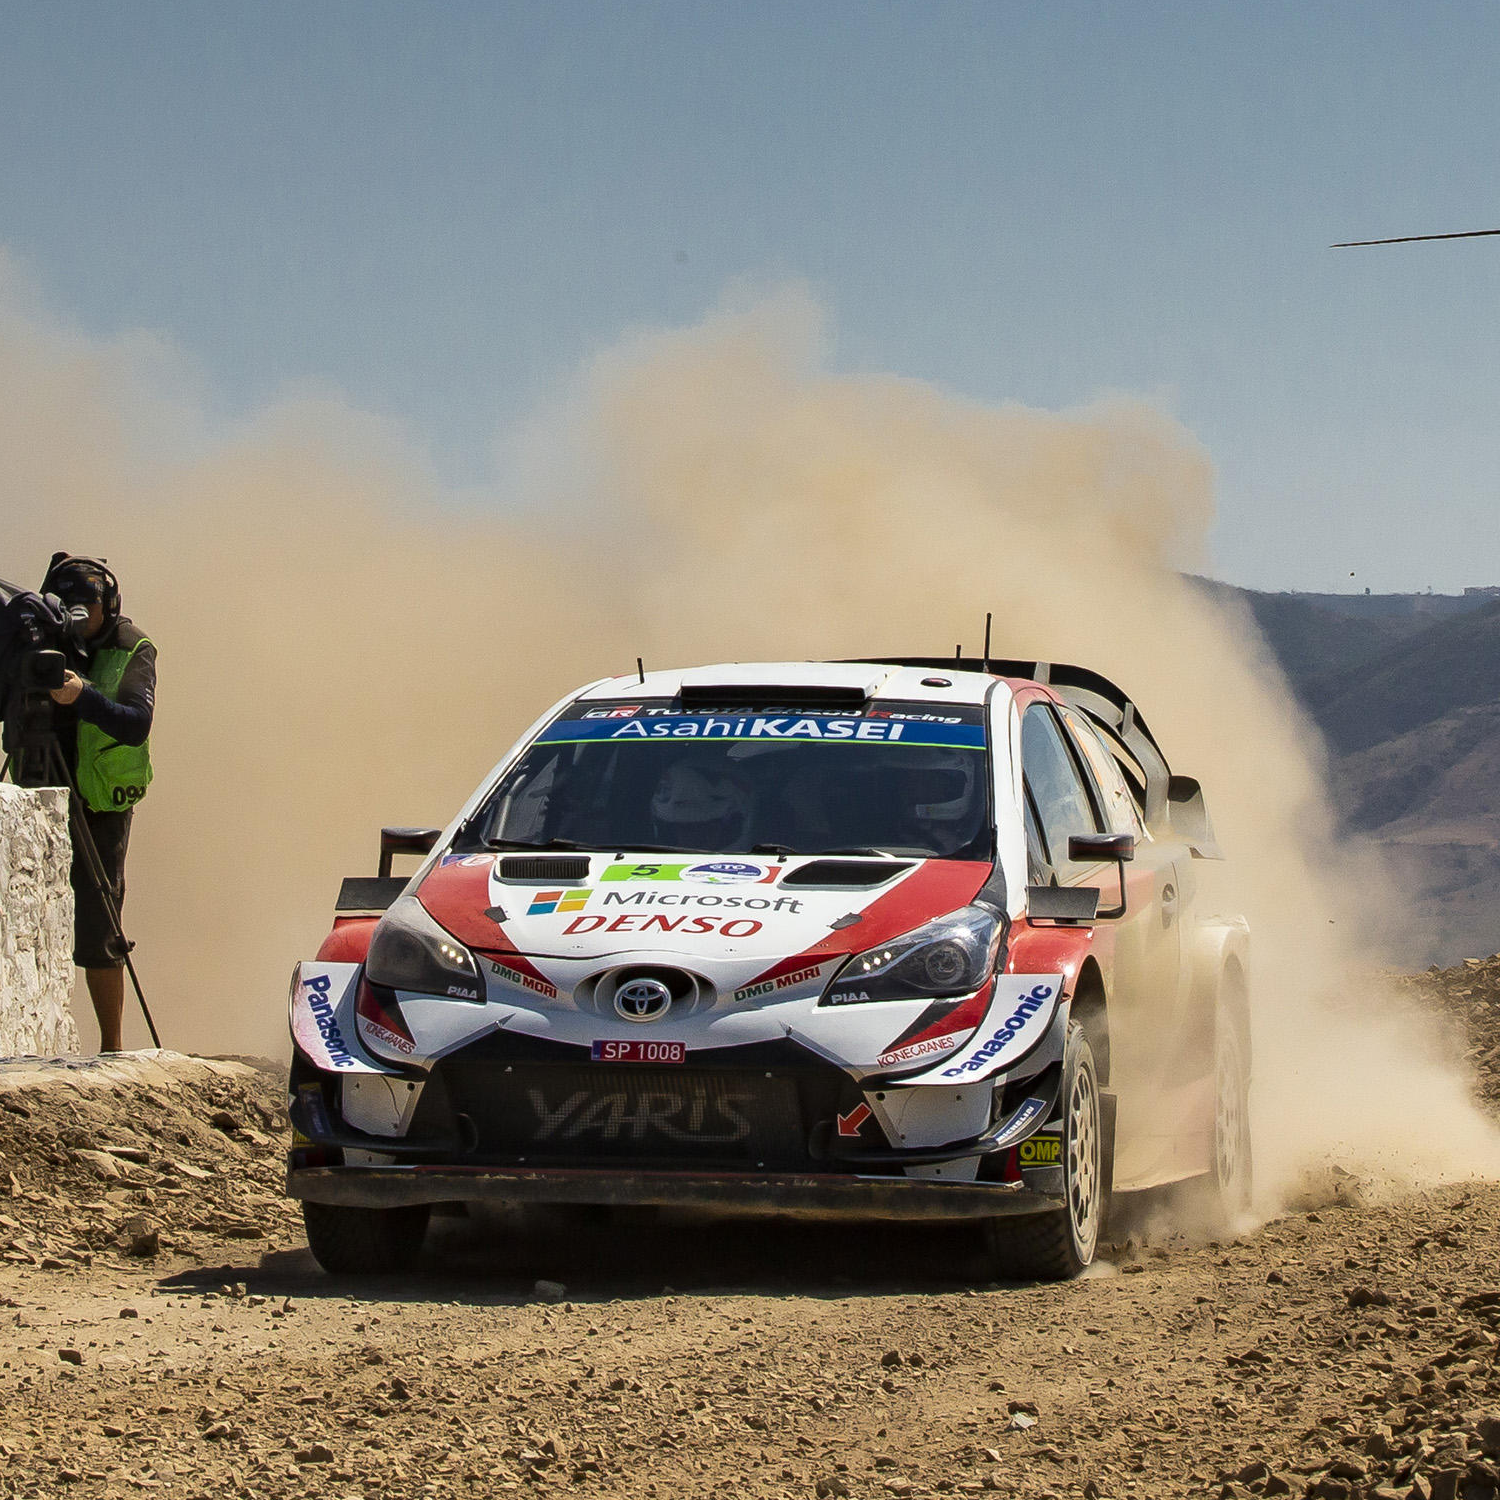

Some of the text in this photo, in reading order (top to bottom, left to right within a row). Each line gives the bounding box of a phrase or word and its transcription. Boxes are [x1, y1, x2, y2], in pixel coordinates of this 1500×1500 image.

[585, 707, 639, 719] GR
[867, 710, 963, 724] Racing
[631, 863, 662, 876] 5
[602, 891, 804, 914] Microsoft
[561, 914, 764, 938] DENSO
[447, 985, 478, 999] PIAA
[491, 962, 558, 999] DMG MORI
[733, 966, 821, 1002] DMG MORI
[831, 991, 870, 1004] PIAA
[303, 974, 358, 1068] Panasonic
[940, 984, 1052, 1078] Panasonic
[363, 1020, 416, 1055] KONECRANES
[604, 1043, 681, 1060] SP 1008
[877, 1036, 955, 1069] KONECRANES
[996, 1105, 1035, 1142] MICHELIN
[1020, 1141, 1061, 1160] OMP
